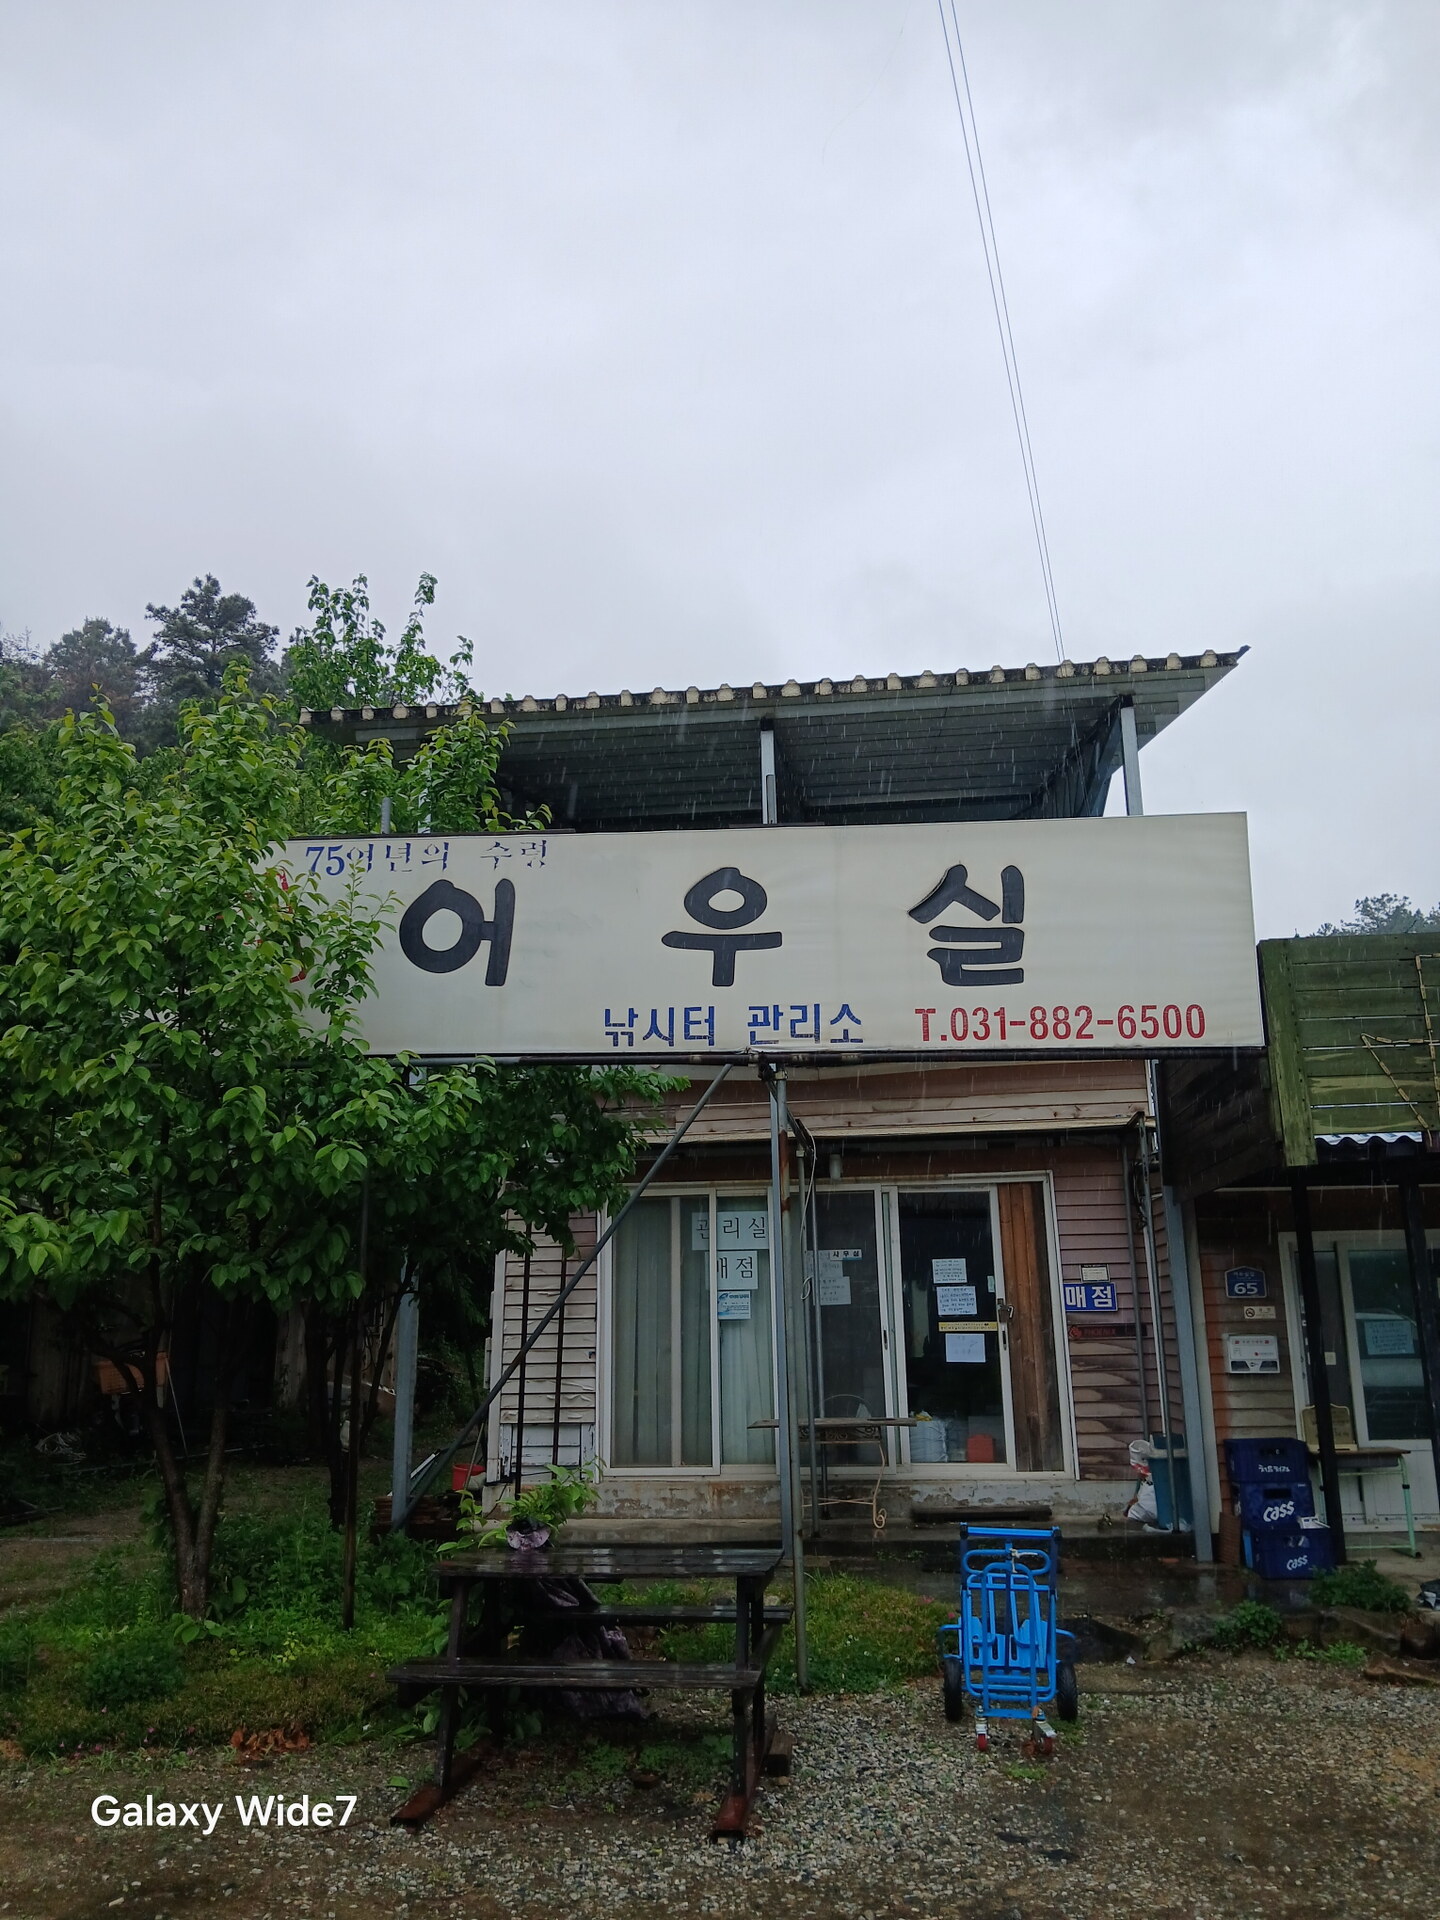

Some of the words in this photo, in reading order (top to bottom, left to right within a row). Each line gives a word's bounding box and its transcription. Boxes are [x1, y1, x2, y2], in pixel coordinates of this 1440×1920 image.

[604, 1006, 715, 1047] 낚시터
[747, 1003, 864, 1046] 관리소
[914, 1004, 1206, 1042] T.031-882-6500
[1065, 1285, 1113, 1308] 매점
[1234, 1282, 1258, 1295] 65
